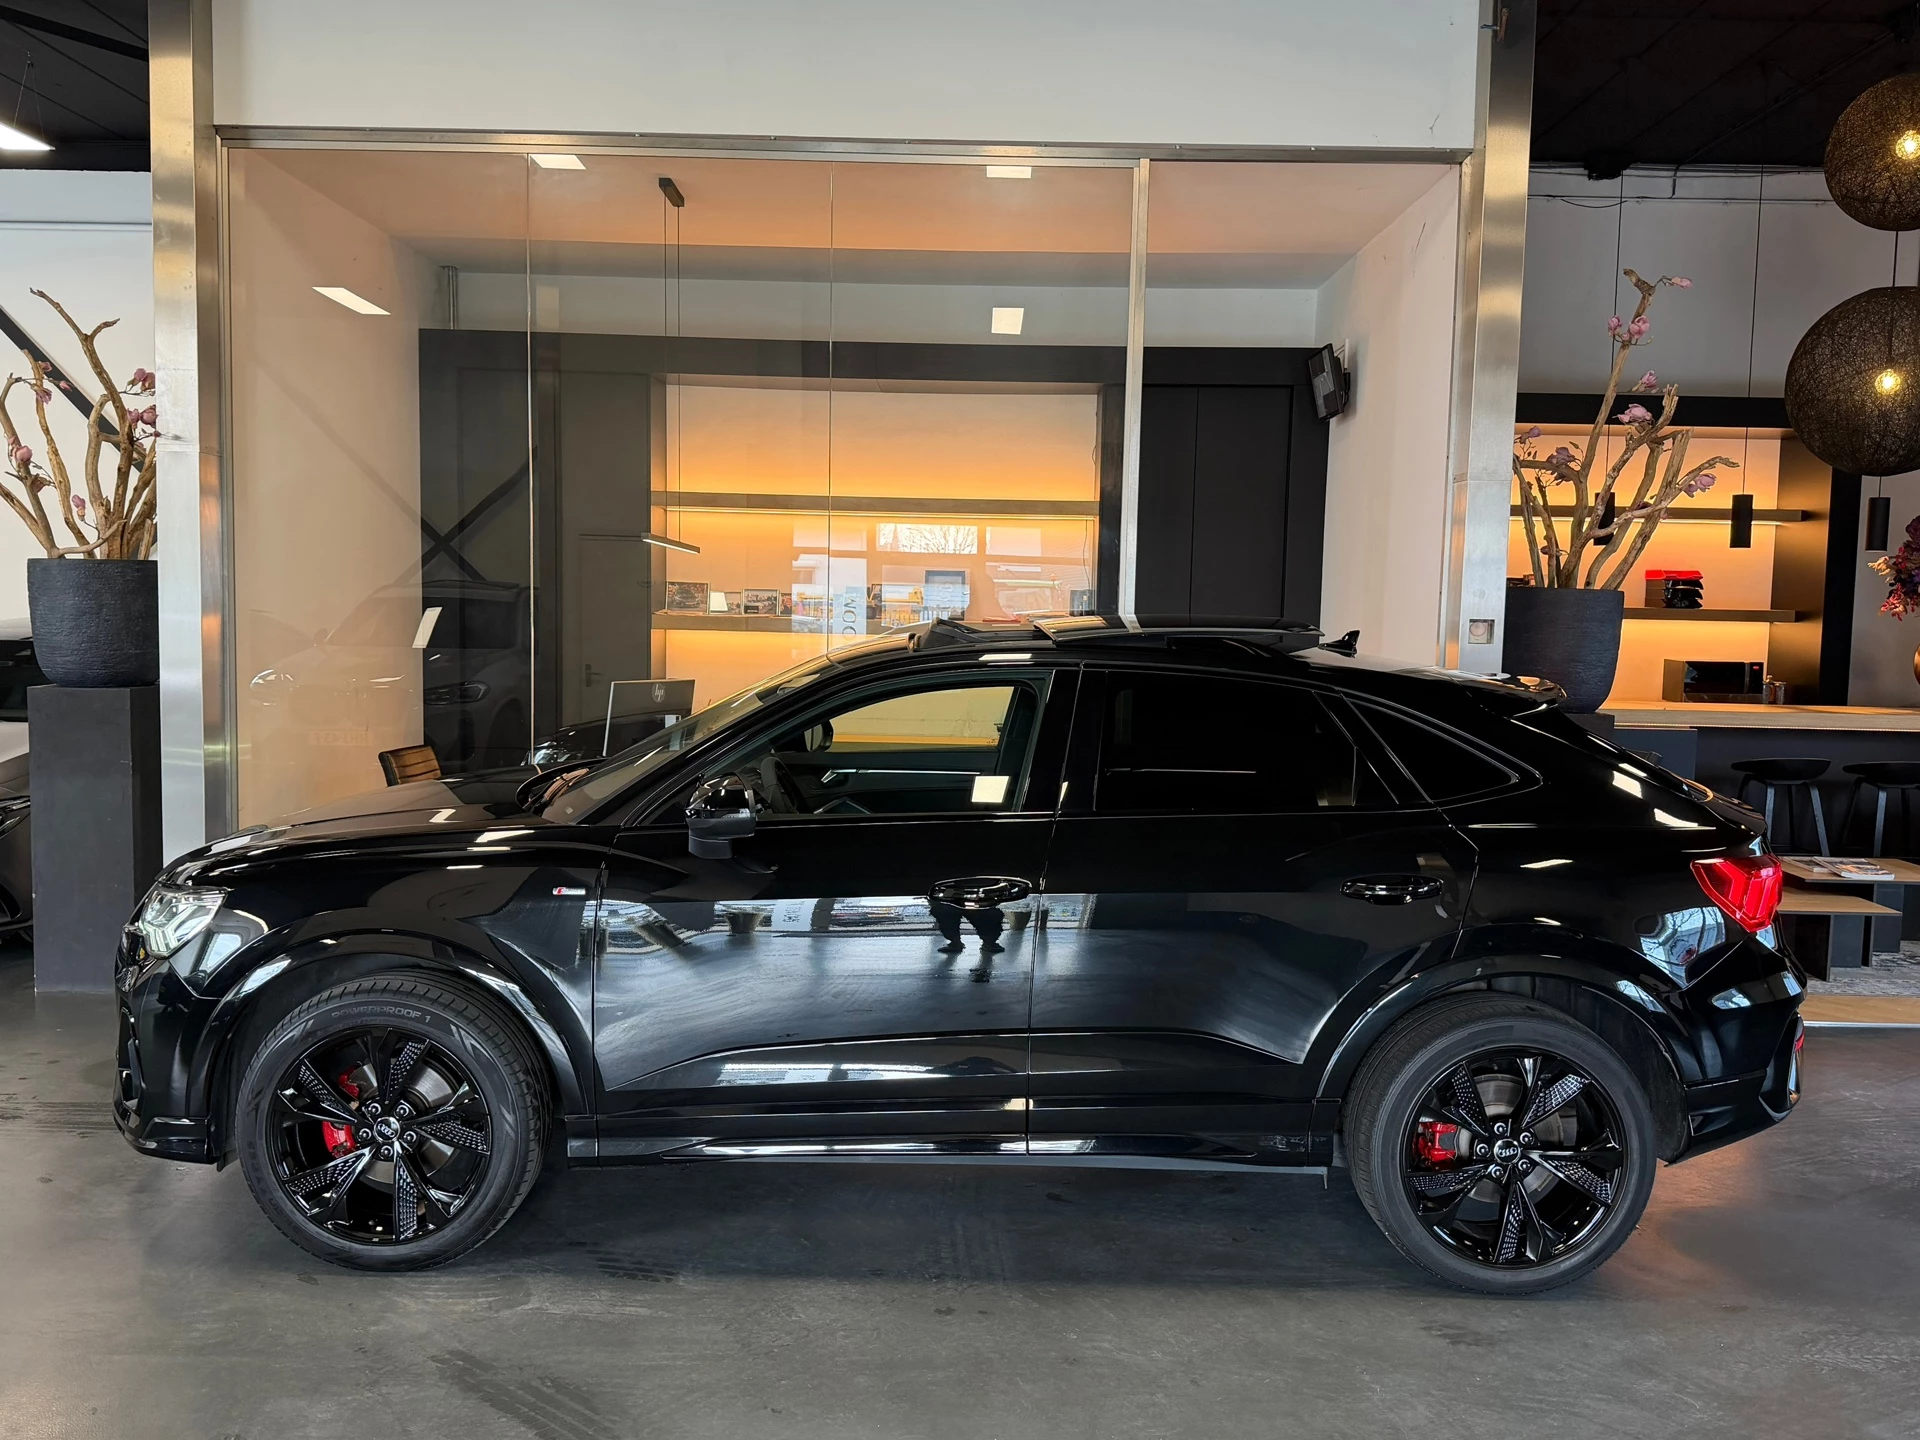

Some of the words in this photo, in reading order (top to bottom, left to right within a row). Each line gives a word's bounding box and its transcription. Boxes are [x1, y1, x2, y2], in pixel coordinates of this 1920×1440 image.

[654, 684, 664, 702] hp
[331, 1005, 422, 1018] POWERPROOF
[424, 1015, 431, 1023] 1
